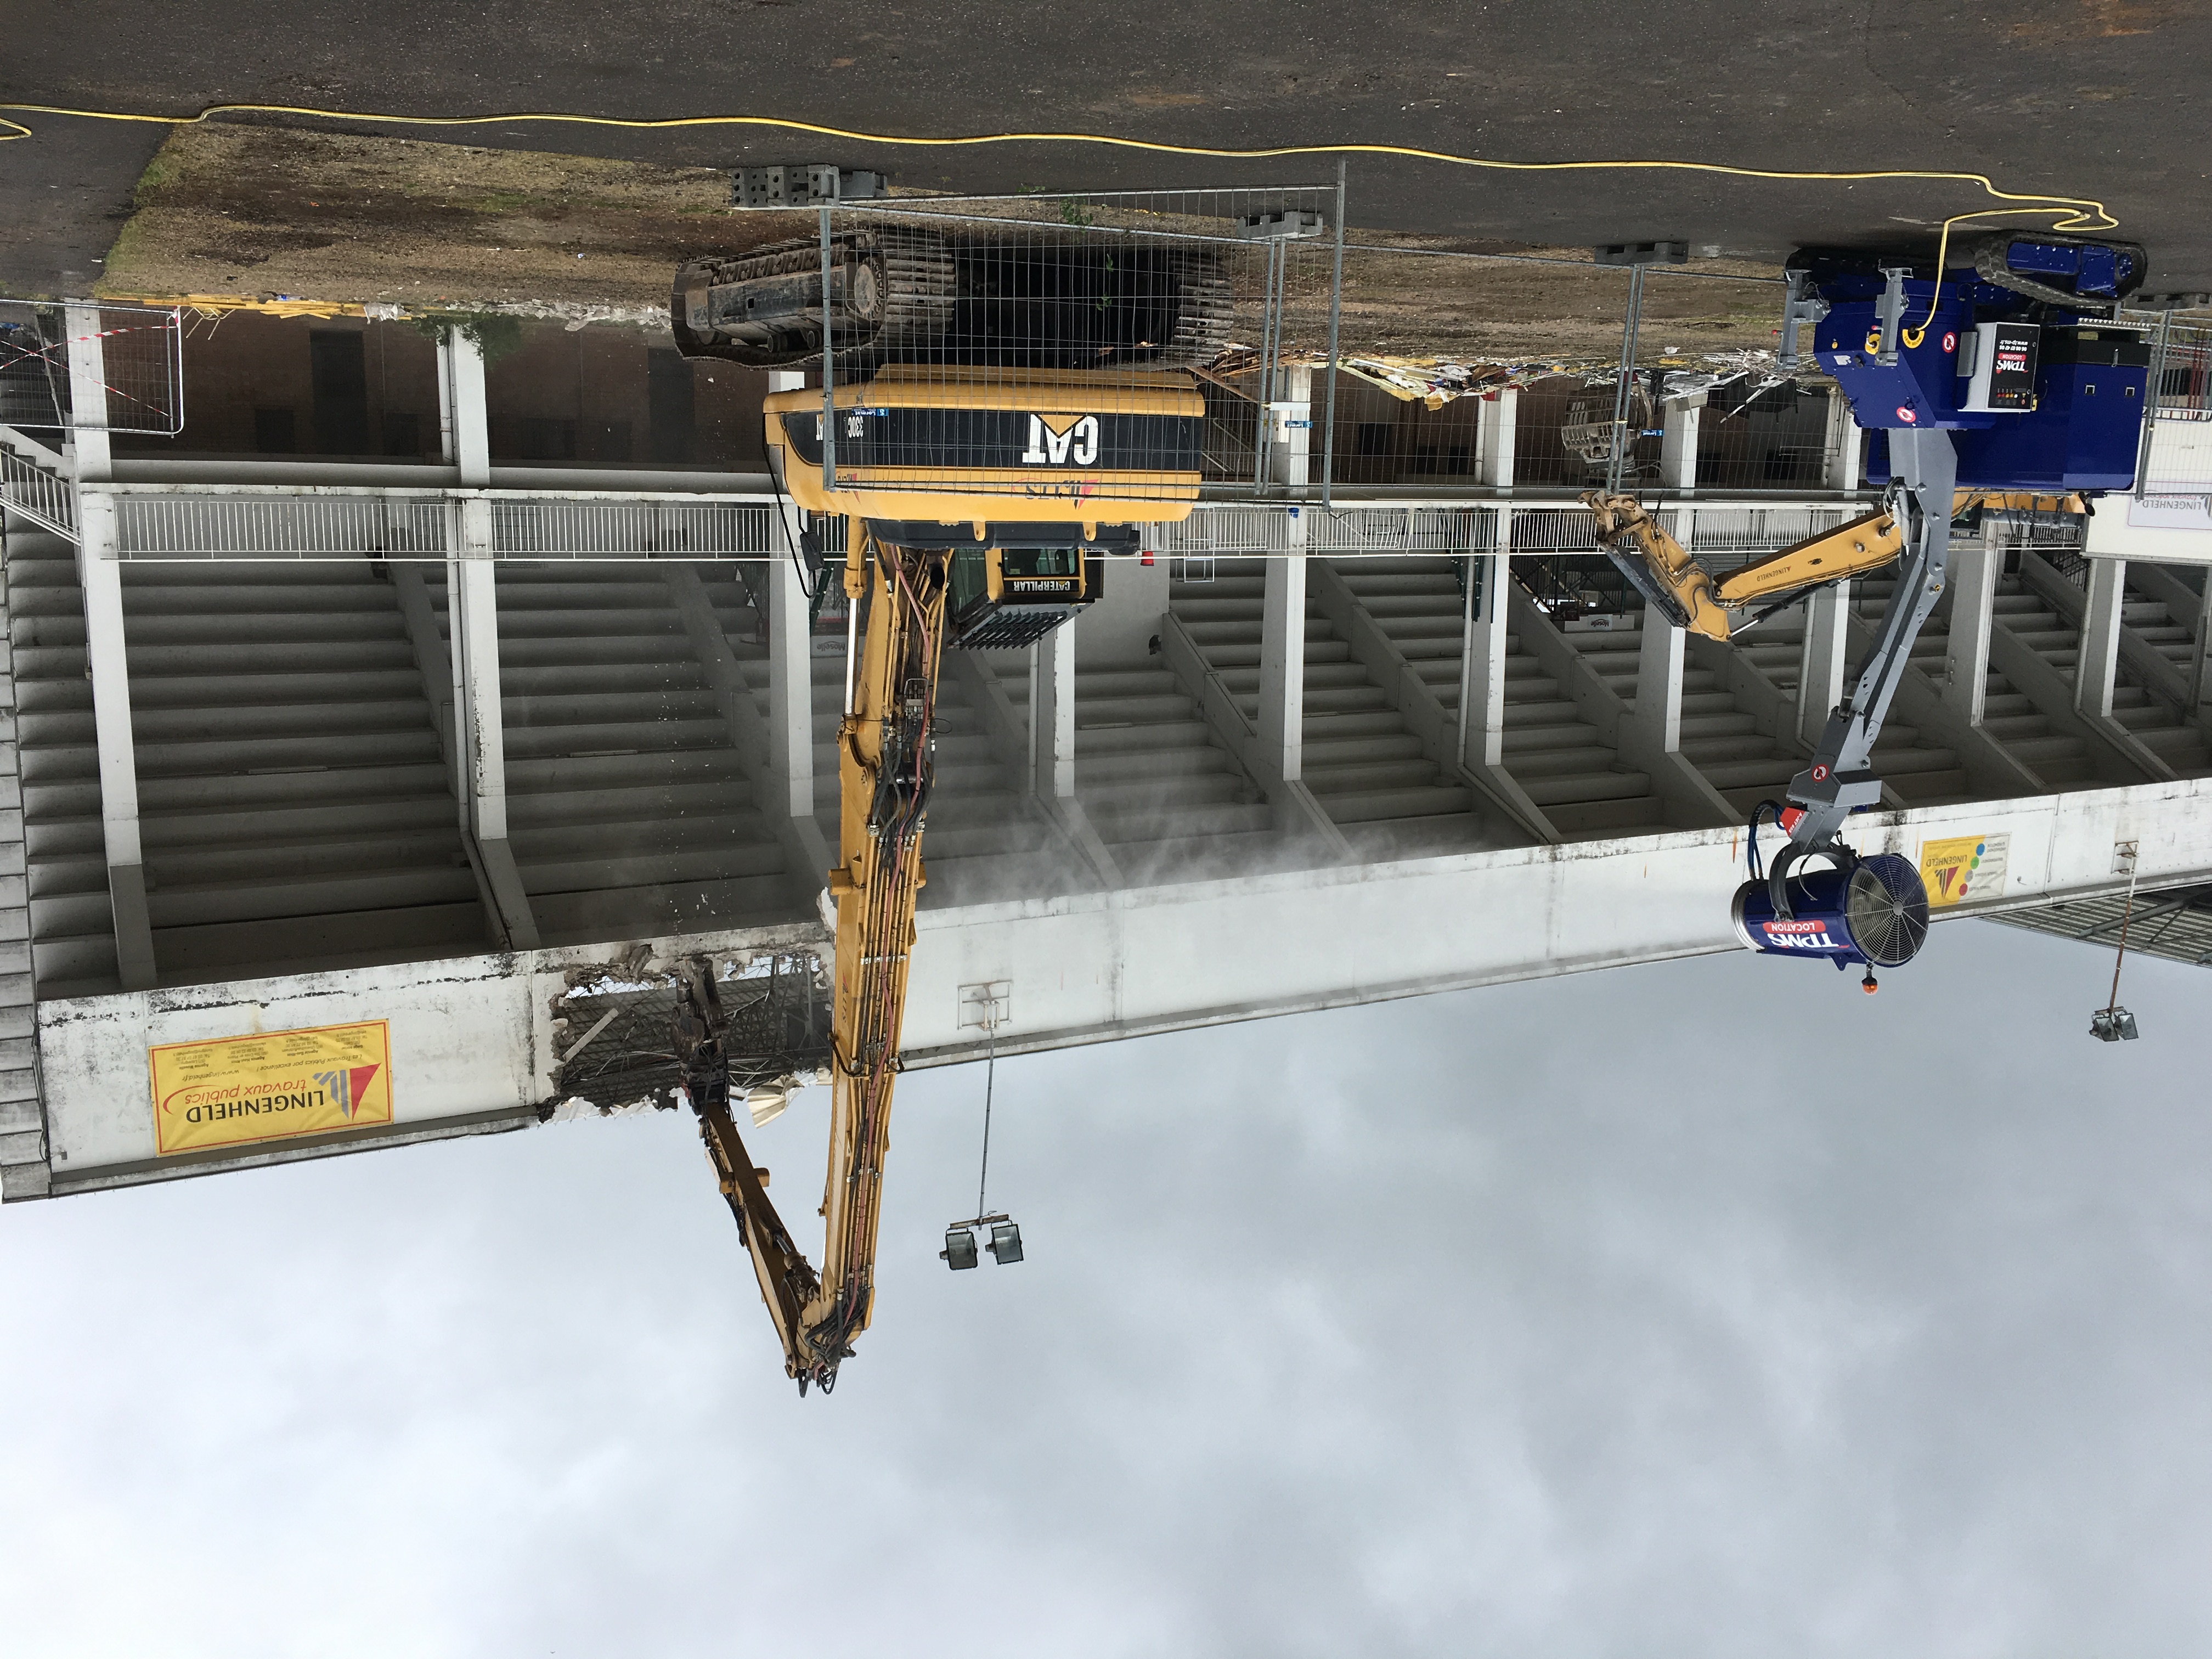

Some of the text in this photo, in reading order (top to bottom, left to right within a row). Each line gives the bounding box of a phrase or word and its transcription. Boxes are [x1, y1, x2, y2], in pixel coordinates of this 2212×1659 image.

[1996, 360, 2025, 371] TPMS
[848, 415, 864, 438] 330C
[1022, 414, 1098, 465] CAT
[2142, 500, 2202, 510] LINGENHELD
[1757, 567, 1786, 582] LINGENHELD
[1013, 581, 1070, 591] CATERPILLAR
[816, 643, 846, 651] Moselle
[1926, 855, 1967, 867] LINGENHELD
[1771, 922, 1815, 932] LOCATION
[1767, 933, 1839, 948] TPMS
[260, 1062, 291, 1071] excellence
[182, 1069, 239, 1081] www.lingenheld.fr
[185, 1080, 307, 1105] travaux publics
[186, 1090, 324, 1123] LINGENHELD
